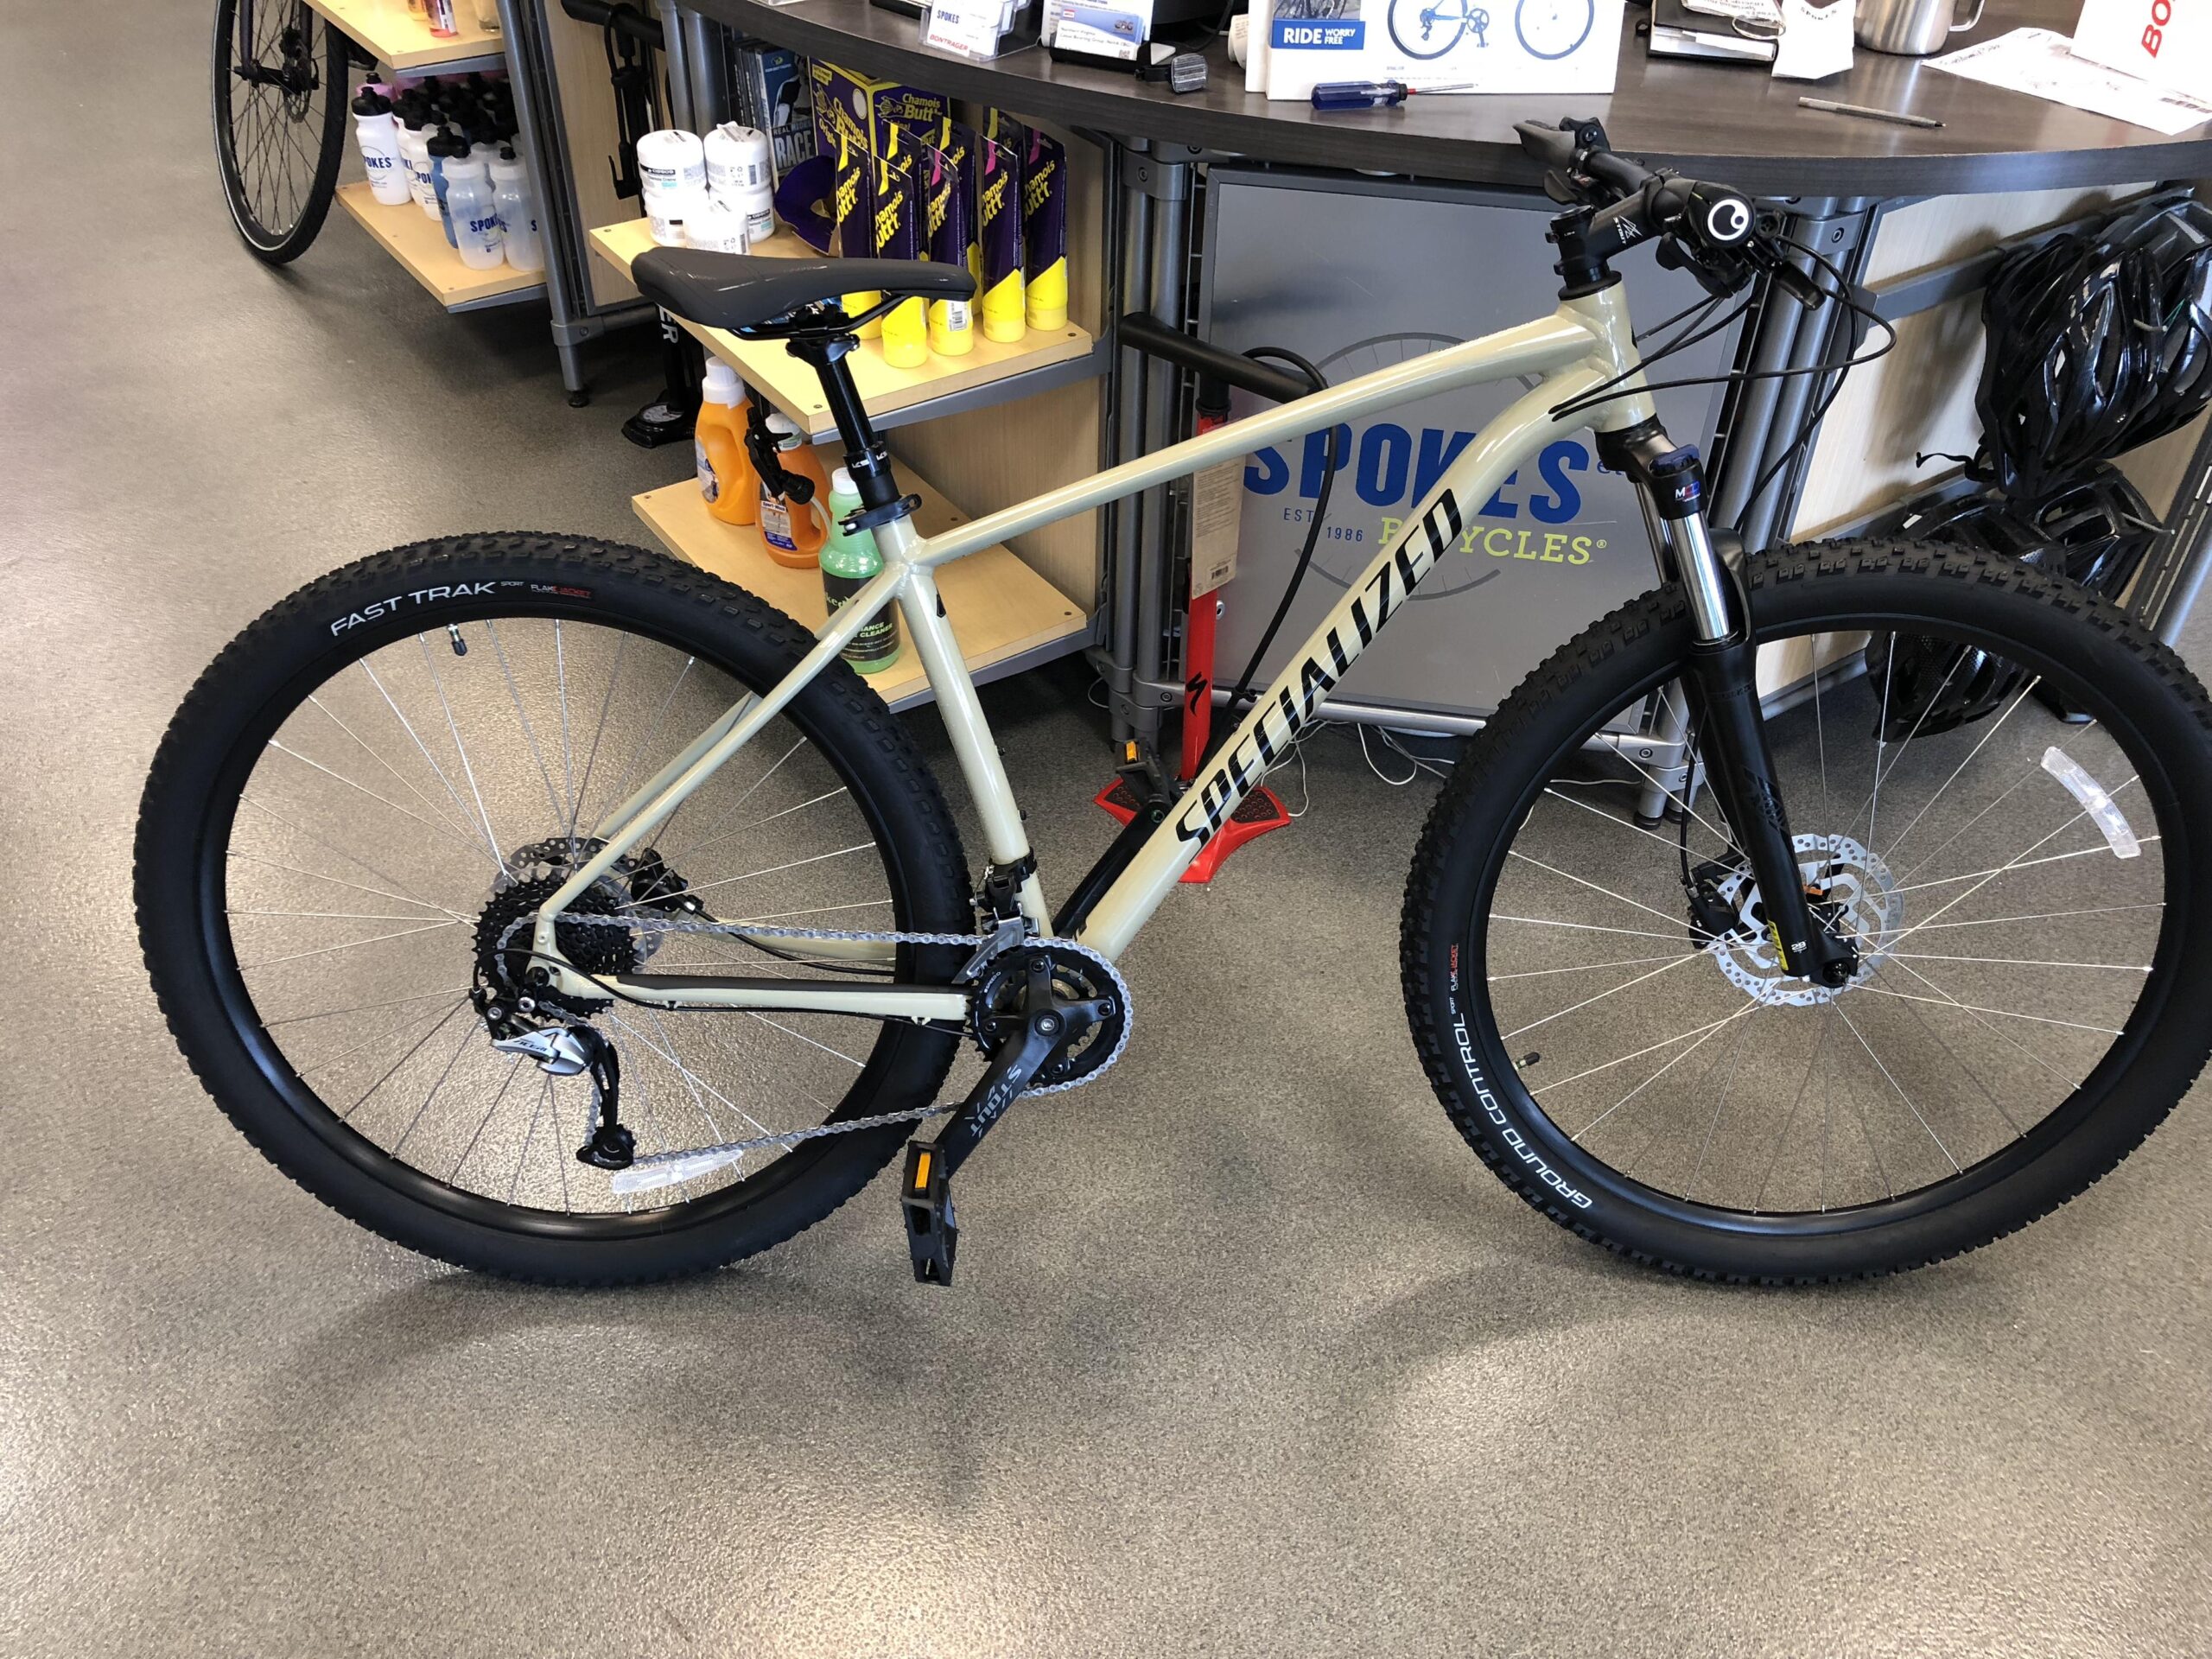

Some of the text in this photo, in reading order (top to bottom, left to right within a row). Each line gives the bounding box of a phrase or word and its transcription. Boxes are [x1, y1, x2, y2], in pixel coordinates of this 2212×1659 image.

[937, 10, 960, 24] SPOKES
[1325, 28, 1356, 37] WORRY
[930, 34, 969, 50] BONTRAGER
[1283, 27, 1323, 44] RIDE
[1324, 36, 1344, 45] FREE
[902, 93, 941, 109] Chamois
[774, 130, 812, 170] RACE
[836, 166, 861, 200] hamois
[982, 170, 1009, 204] hamois
[1024, 160, 1056, 199] hamois
[875, 190, 904, 230] hamois
[1284, 507, 1363, 542] EST 1986
[330, 596, 403, 637] FAST
[408, 582, 498, 605] TRAK
[859, 622, 893, 638] CLEANER
[1175, 488, 1463, 865] SPECIALIZED
[1453, 1013, 1507, 1125] CONTROL
[969, 1064, 1022, 1137] STOUT
[1502, 1128, 1593, 1210] GROUND
